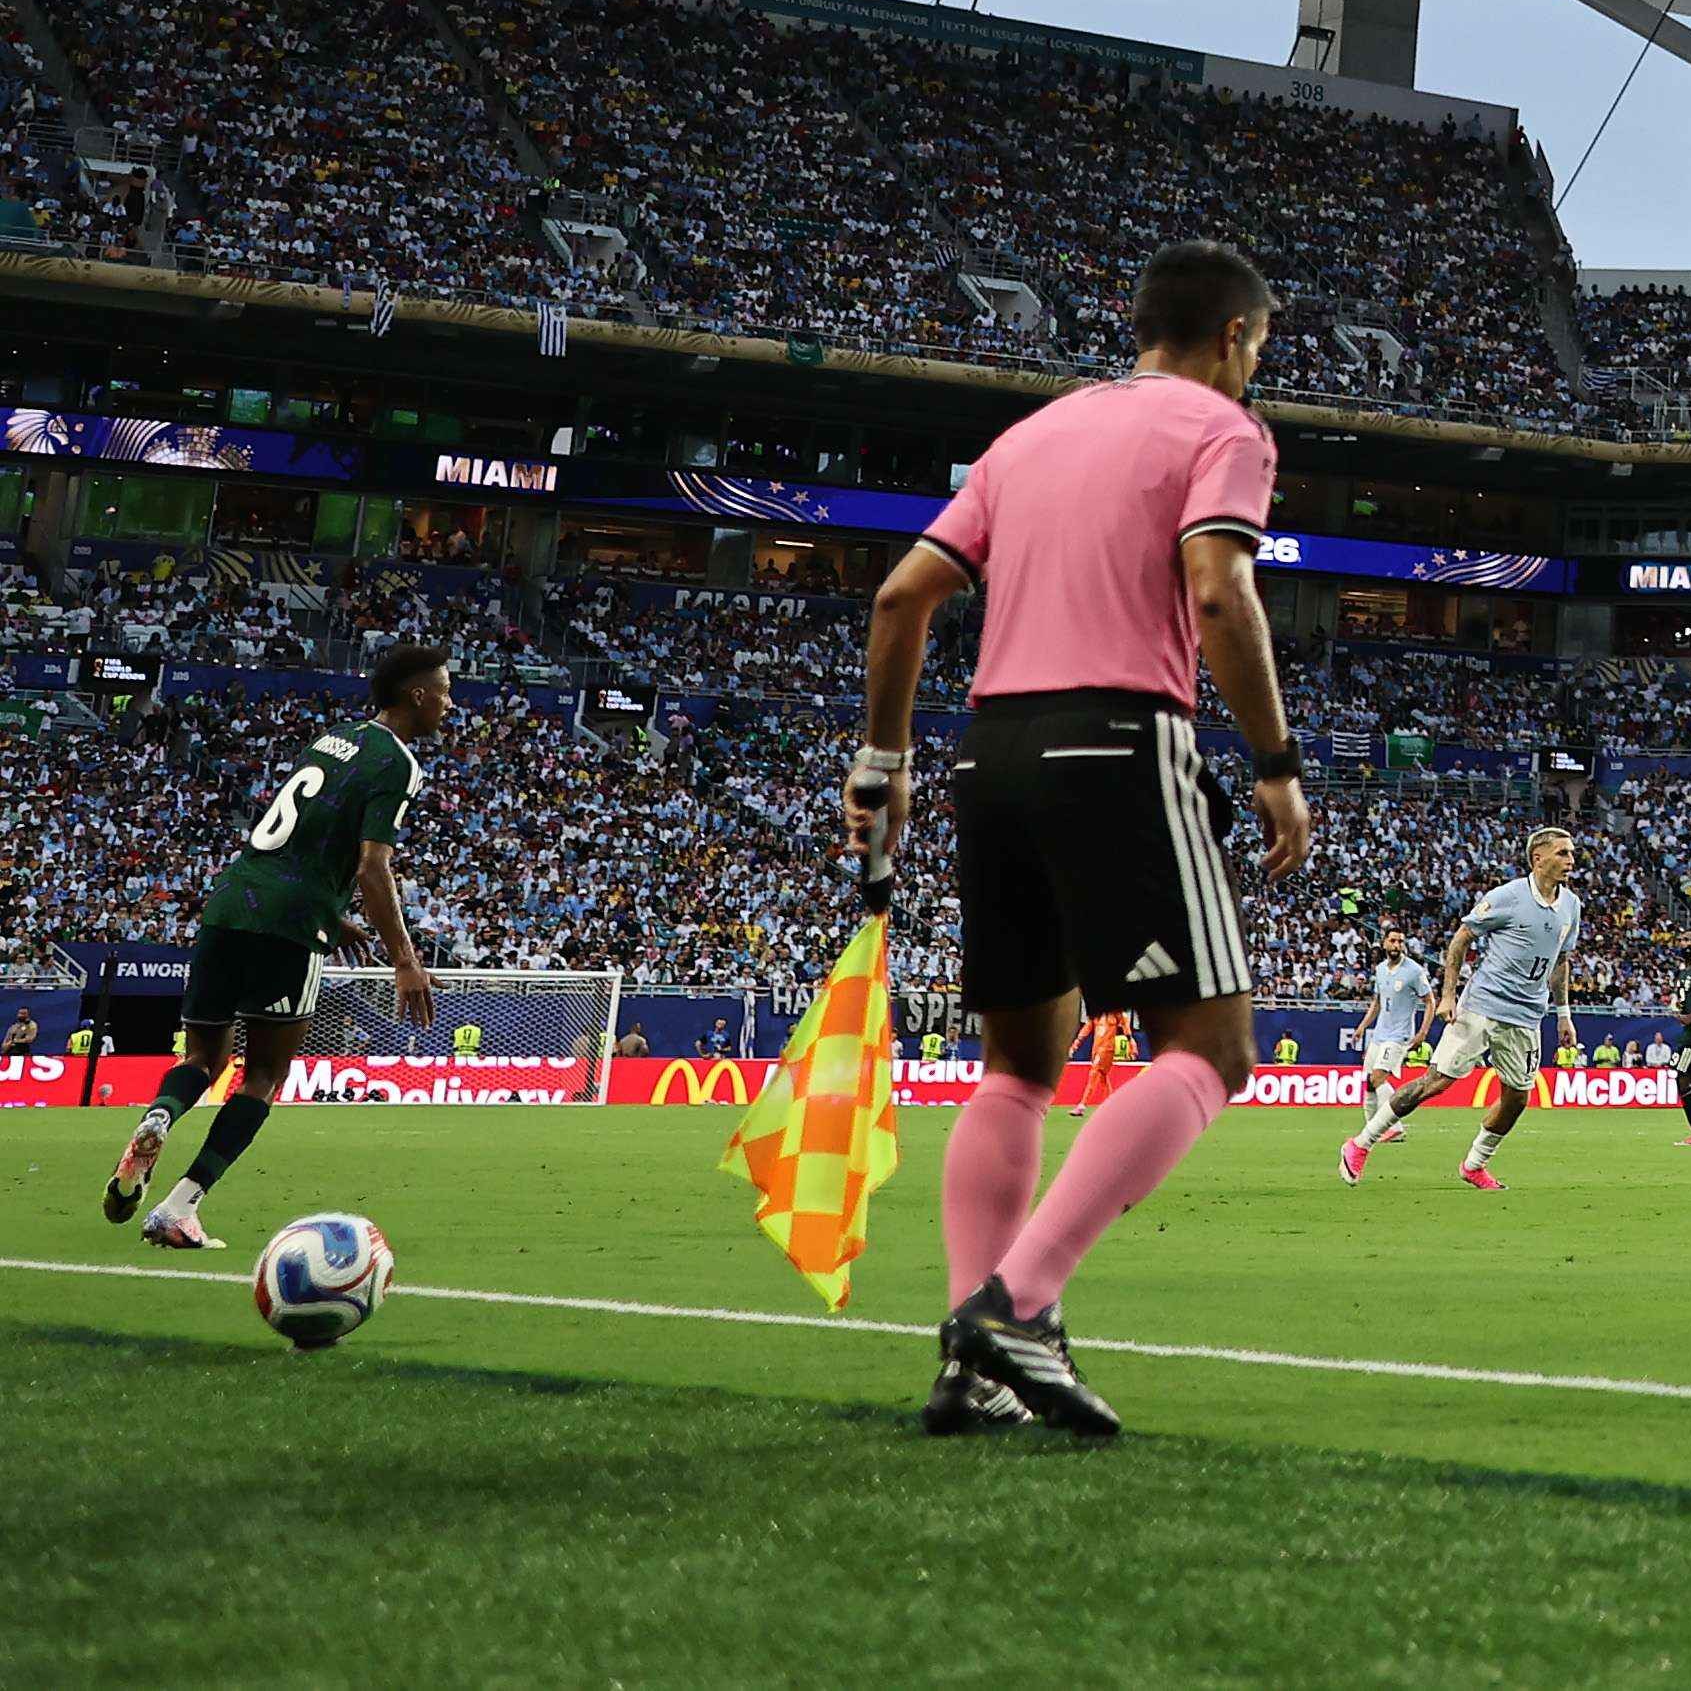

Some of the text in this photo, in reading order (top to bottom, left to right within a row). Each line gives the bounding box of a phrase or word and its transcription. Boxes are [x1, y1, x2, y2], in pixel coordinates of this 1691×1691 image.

[1290, 81, 1324, 102] 308
[436, 455, 557, 492] MIAMI
[1257, 536, 1301, 563] 26
[250, 766, 325, 851] 6
[1529, 956, 1548, 982] 13
[1383, 1048, 1390, 1062] 6
